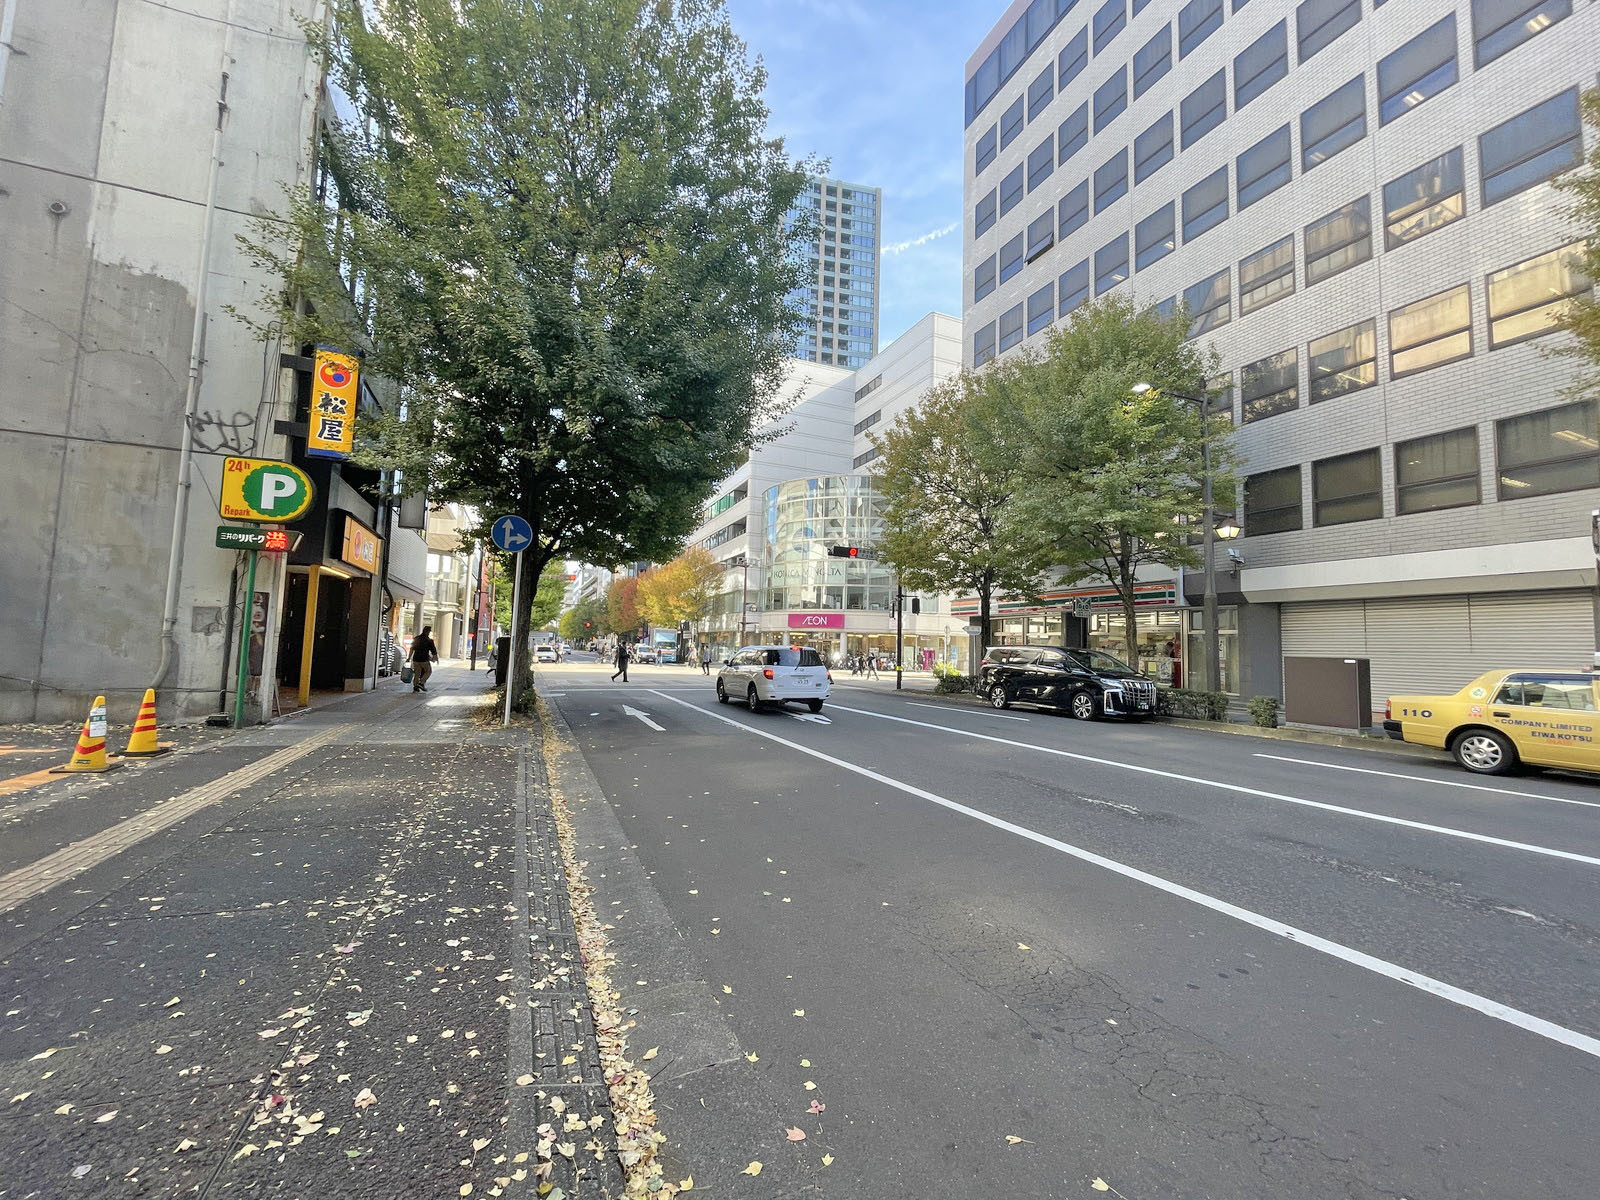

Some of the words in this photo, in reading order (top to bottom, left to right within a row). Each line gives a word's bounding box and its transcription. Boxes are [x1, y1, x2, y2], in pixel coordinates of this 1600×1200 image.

[317, 391, 347, 442] 松屋
[228, 460, 250, 472] 24h
[260, 472, 297, 510] P
[224, 505, 250, 517] Repark
[220, 532, 265, 544] 三井のリパーク
[1402, 709, 1432, 718] 110
[1501, 719, 1548, 728] COMPANY
[1550, 723, 1593, 732] LIMITED
[1531, 731, 1555, 739] EIWA
[1557, 733, 1593, 742] KOTSU
